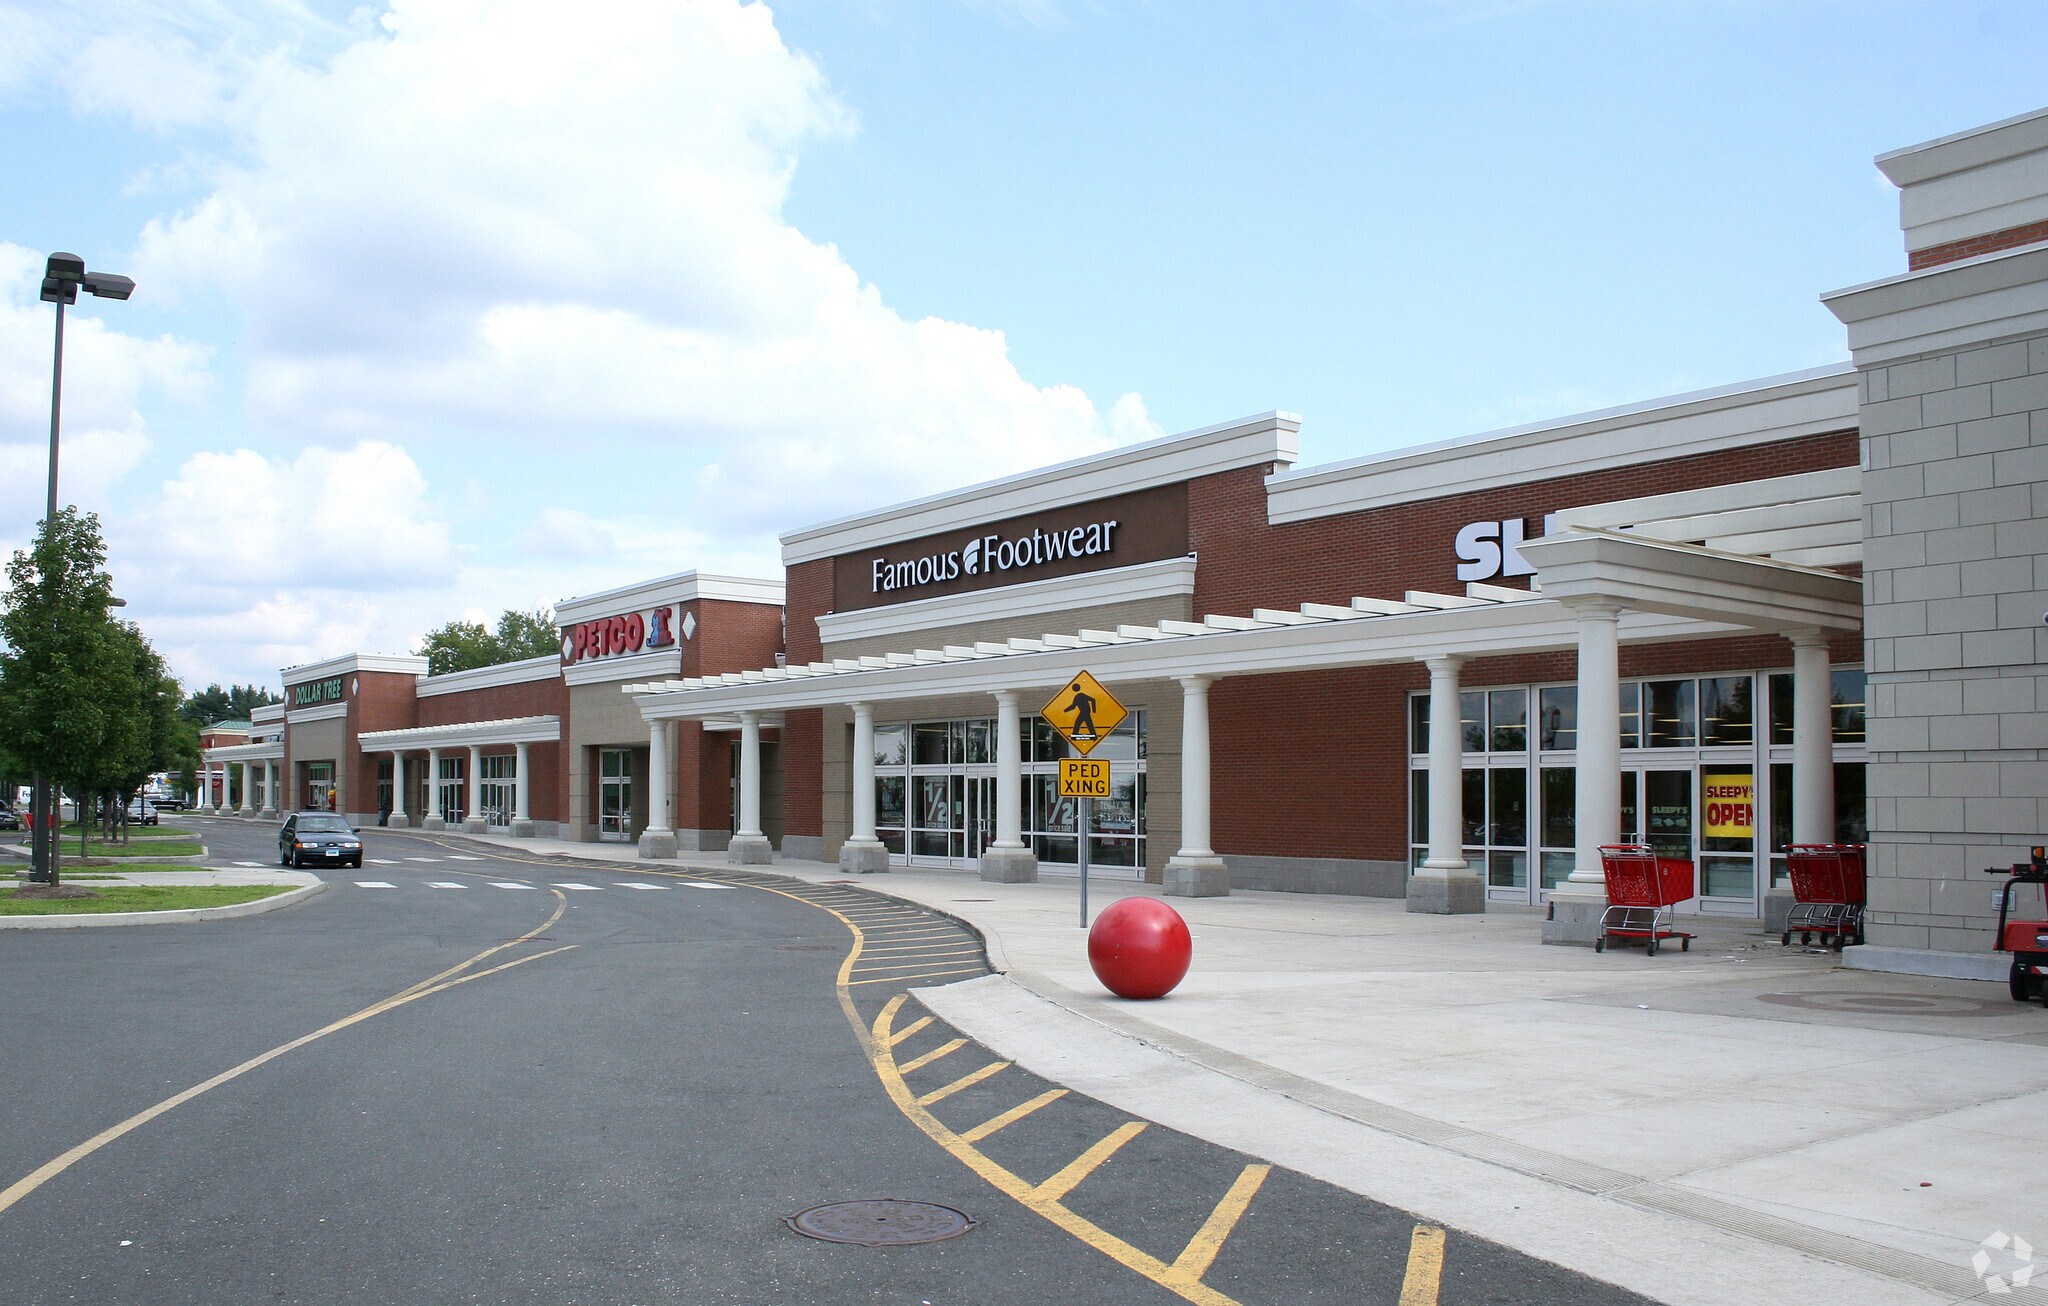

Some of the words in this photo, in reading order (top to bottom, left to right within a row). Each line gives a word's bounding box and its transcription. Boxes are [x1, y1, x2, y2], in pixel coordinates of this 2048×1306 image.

[872, 551, 959, 593] Famous
[984, 520, 1117, 572] Footwear
[575, 613, 644, 660] PETCO
[295, 683, 321, 705] DOLLAR
[324, 679, 342, 700] TREE
[1069, 764, 1100, 777] PED
[1064, 780, 1105, 793] XING
[1651, 806, 1688, 814] SLEEPY'S
